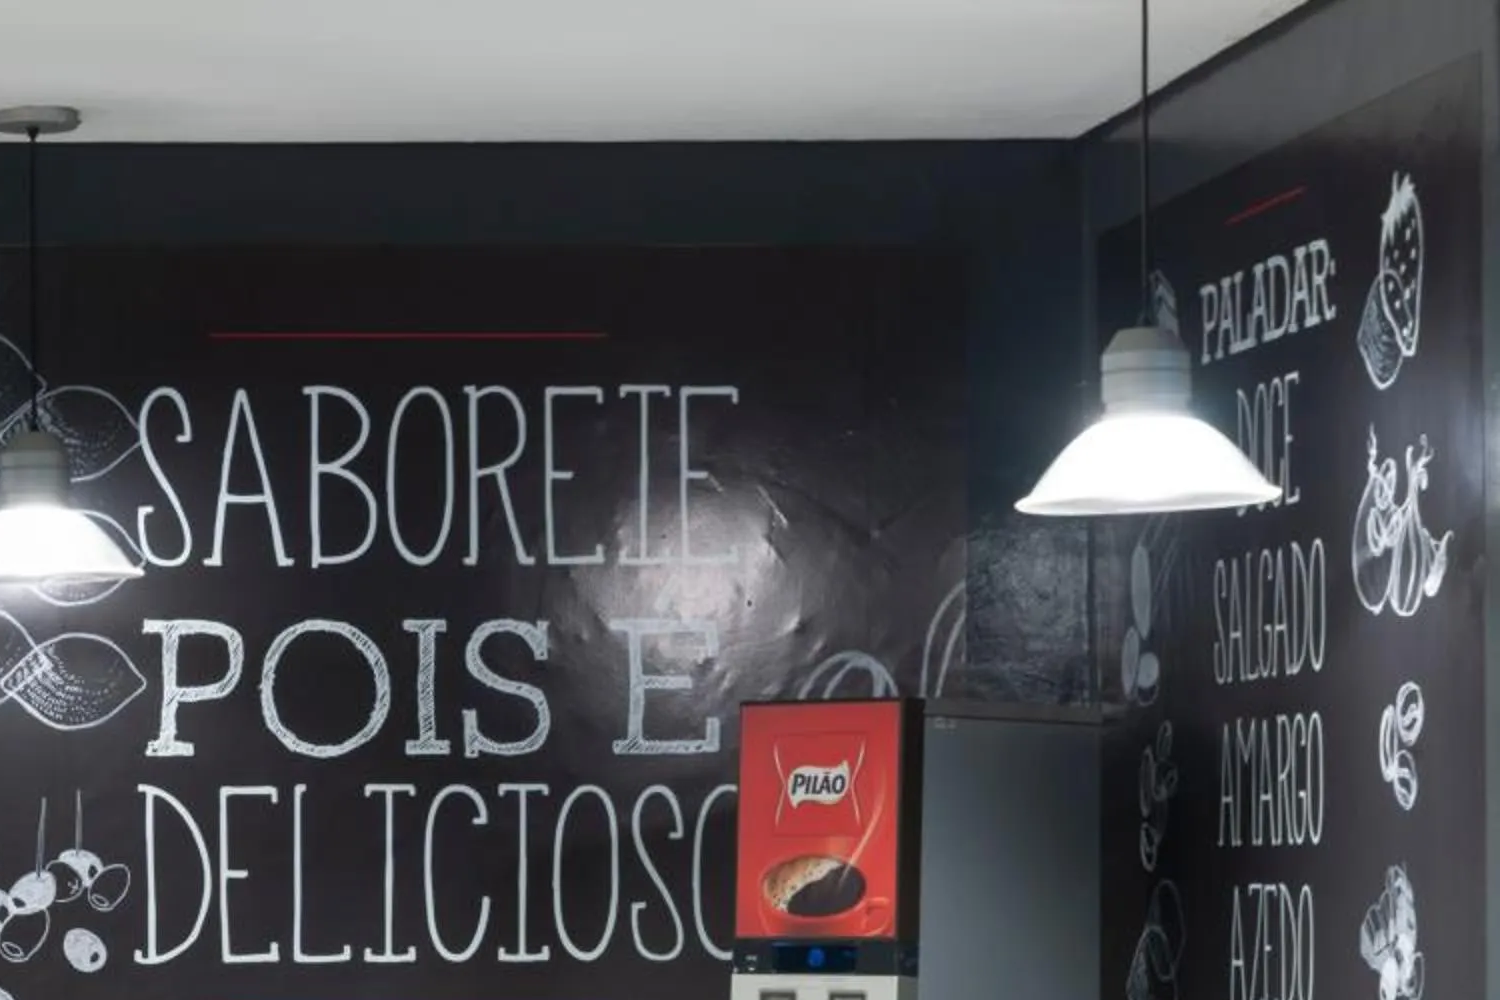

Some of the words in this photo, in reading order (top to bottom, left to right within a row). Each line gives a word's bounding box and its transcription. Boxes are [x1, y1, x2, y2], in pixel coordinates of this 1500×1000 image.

[1213, 537, 1327, 685] SALGADO
[142, 617, 552, 758] POIS
[790, 768, 847, 797] PILÃO
[1218, 710, 1325, 847] AMARGO
